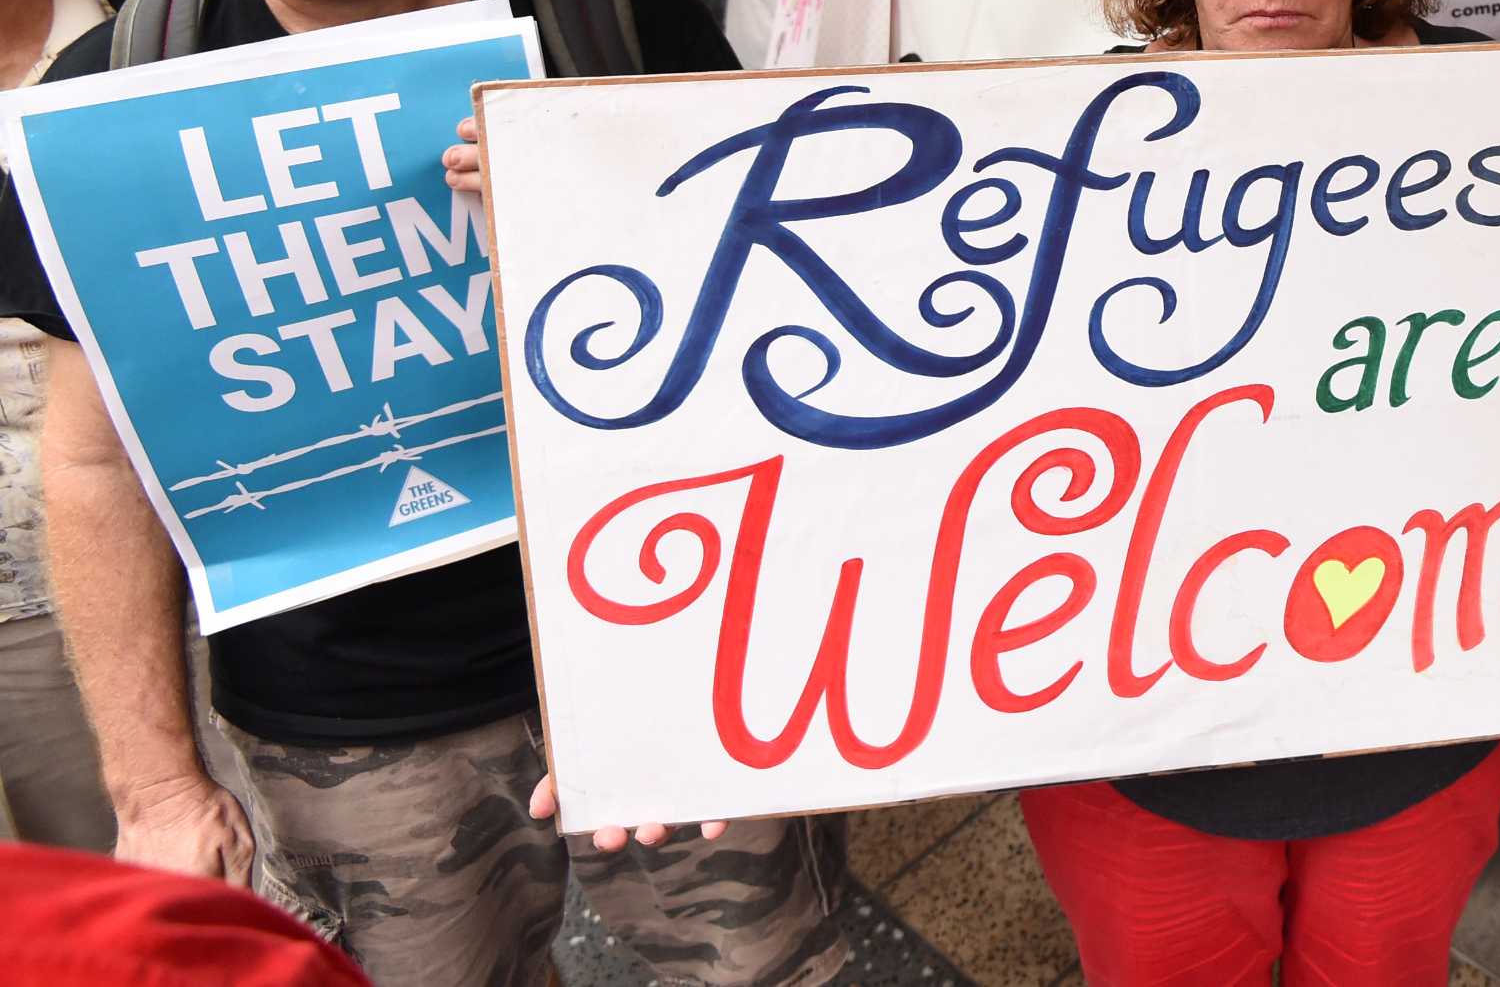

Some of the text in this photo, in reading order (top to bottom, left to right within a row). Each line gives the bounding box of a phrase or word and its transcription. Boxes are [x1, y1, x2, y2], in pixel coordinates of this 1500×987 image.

[179, 92, 402, 222] LET
[135, 189, 489, 331] THEM
[208, 271, 492, 413] STAY
[399, 489, 454, 517] GREENS
[407, 480, 437, 499] THE
